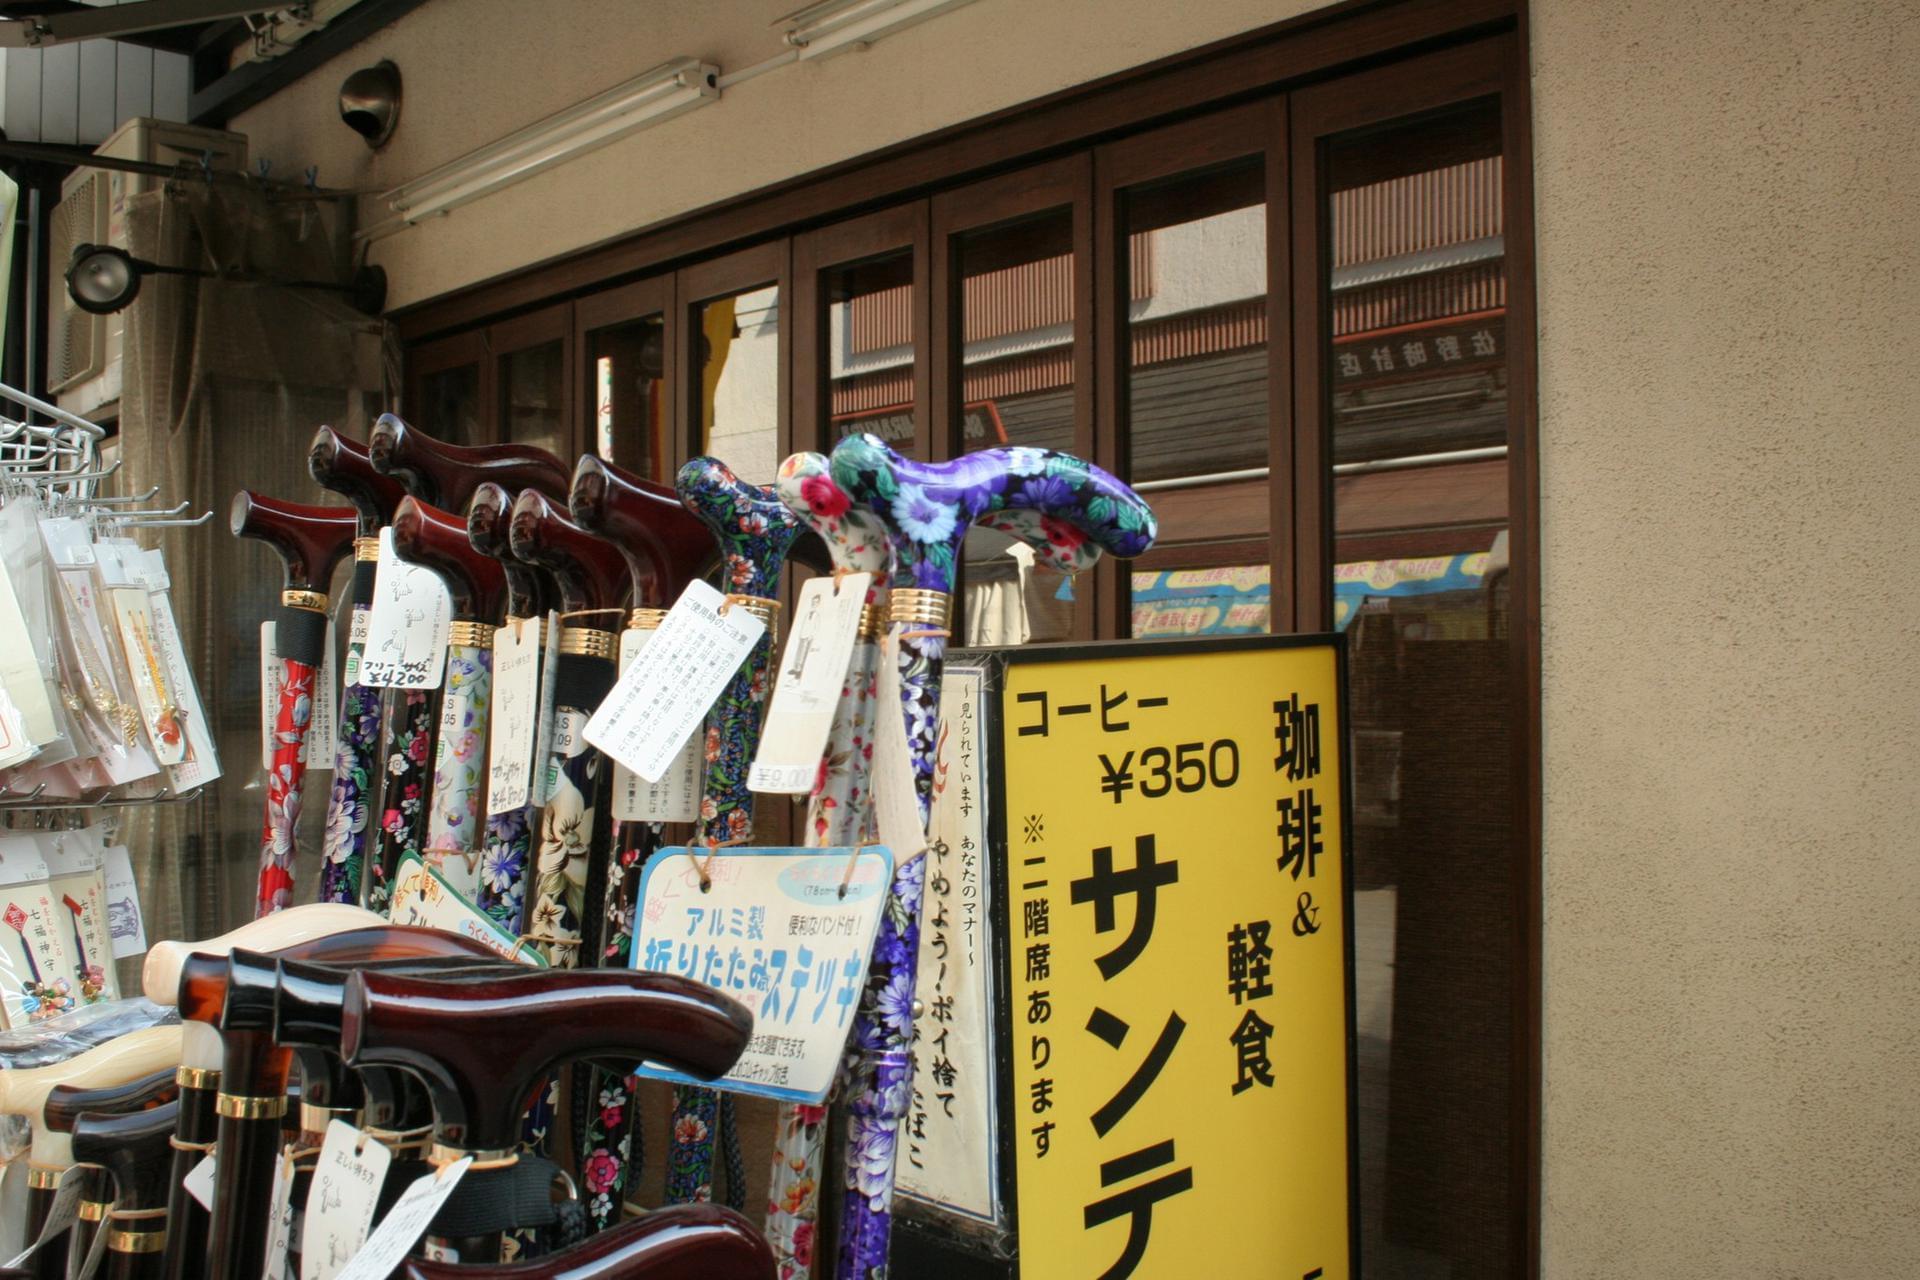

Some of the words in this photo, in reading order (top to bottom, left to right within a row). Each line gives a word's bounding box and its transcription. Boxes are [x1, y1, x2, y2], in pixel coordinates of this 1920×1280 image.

[682, 595, 750, 646] ご使用時のご注意
[1016, 684, 1169, 738] コーヒー
[1098, 738, 1240, 804] ¥350
[686, 905, 766, 941] アルミ製
[1226, 919, 1275, 1097] 軽食
